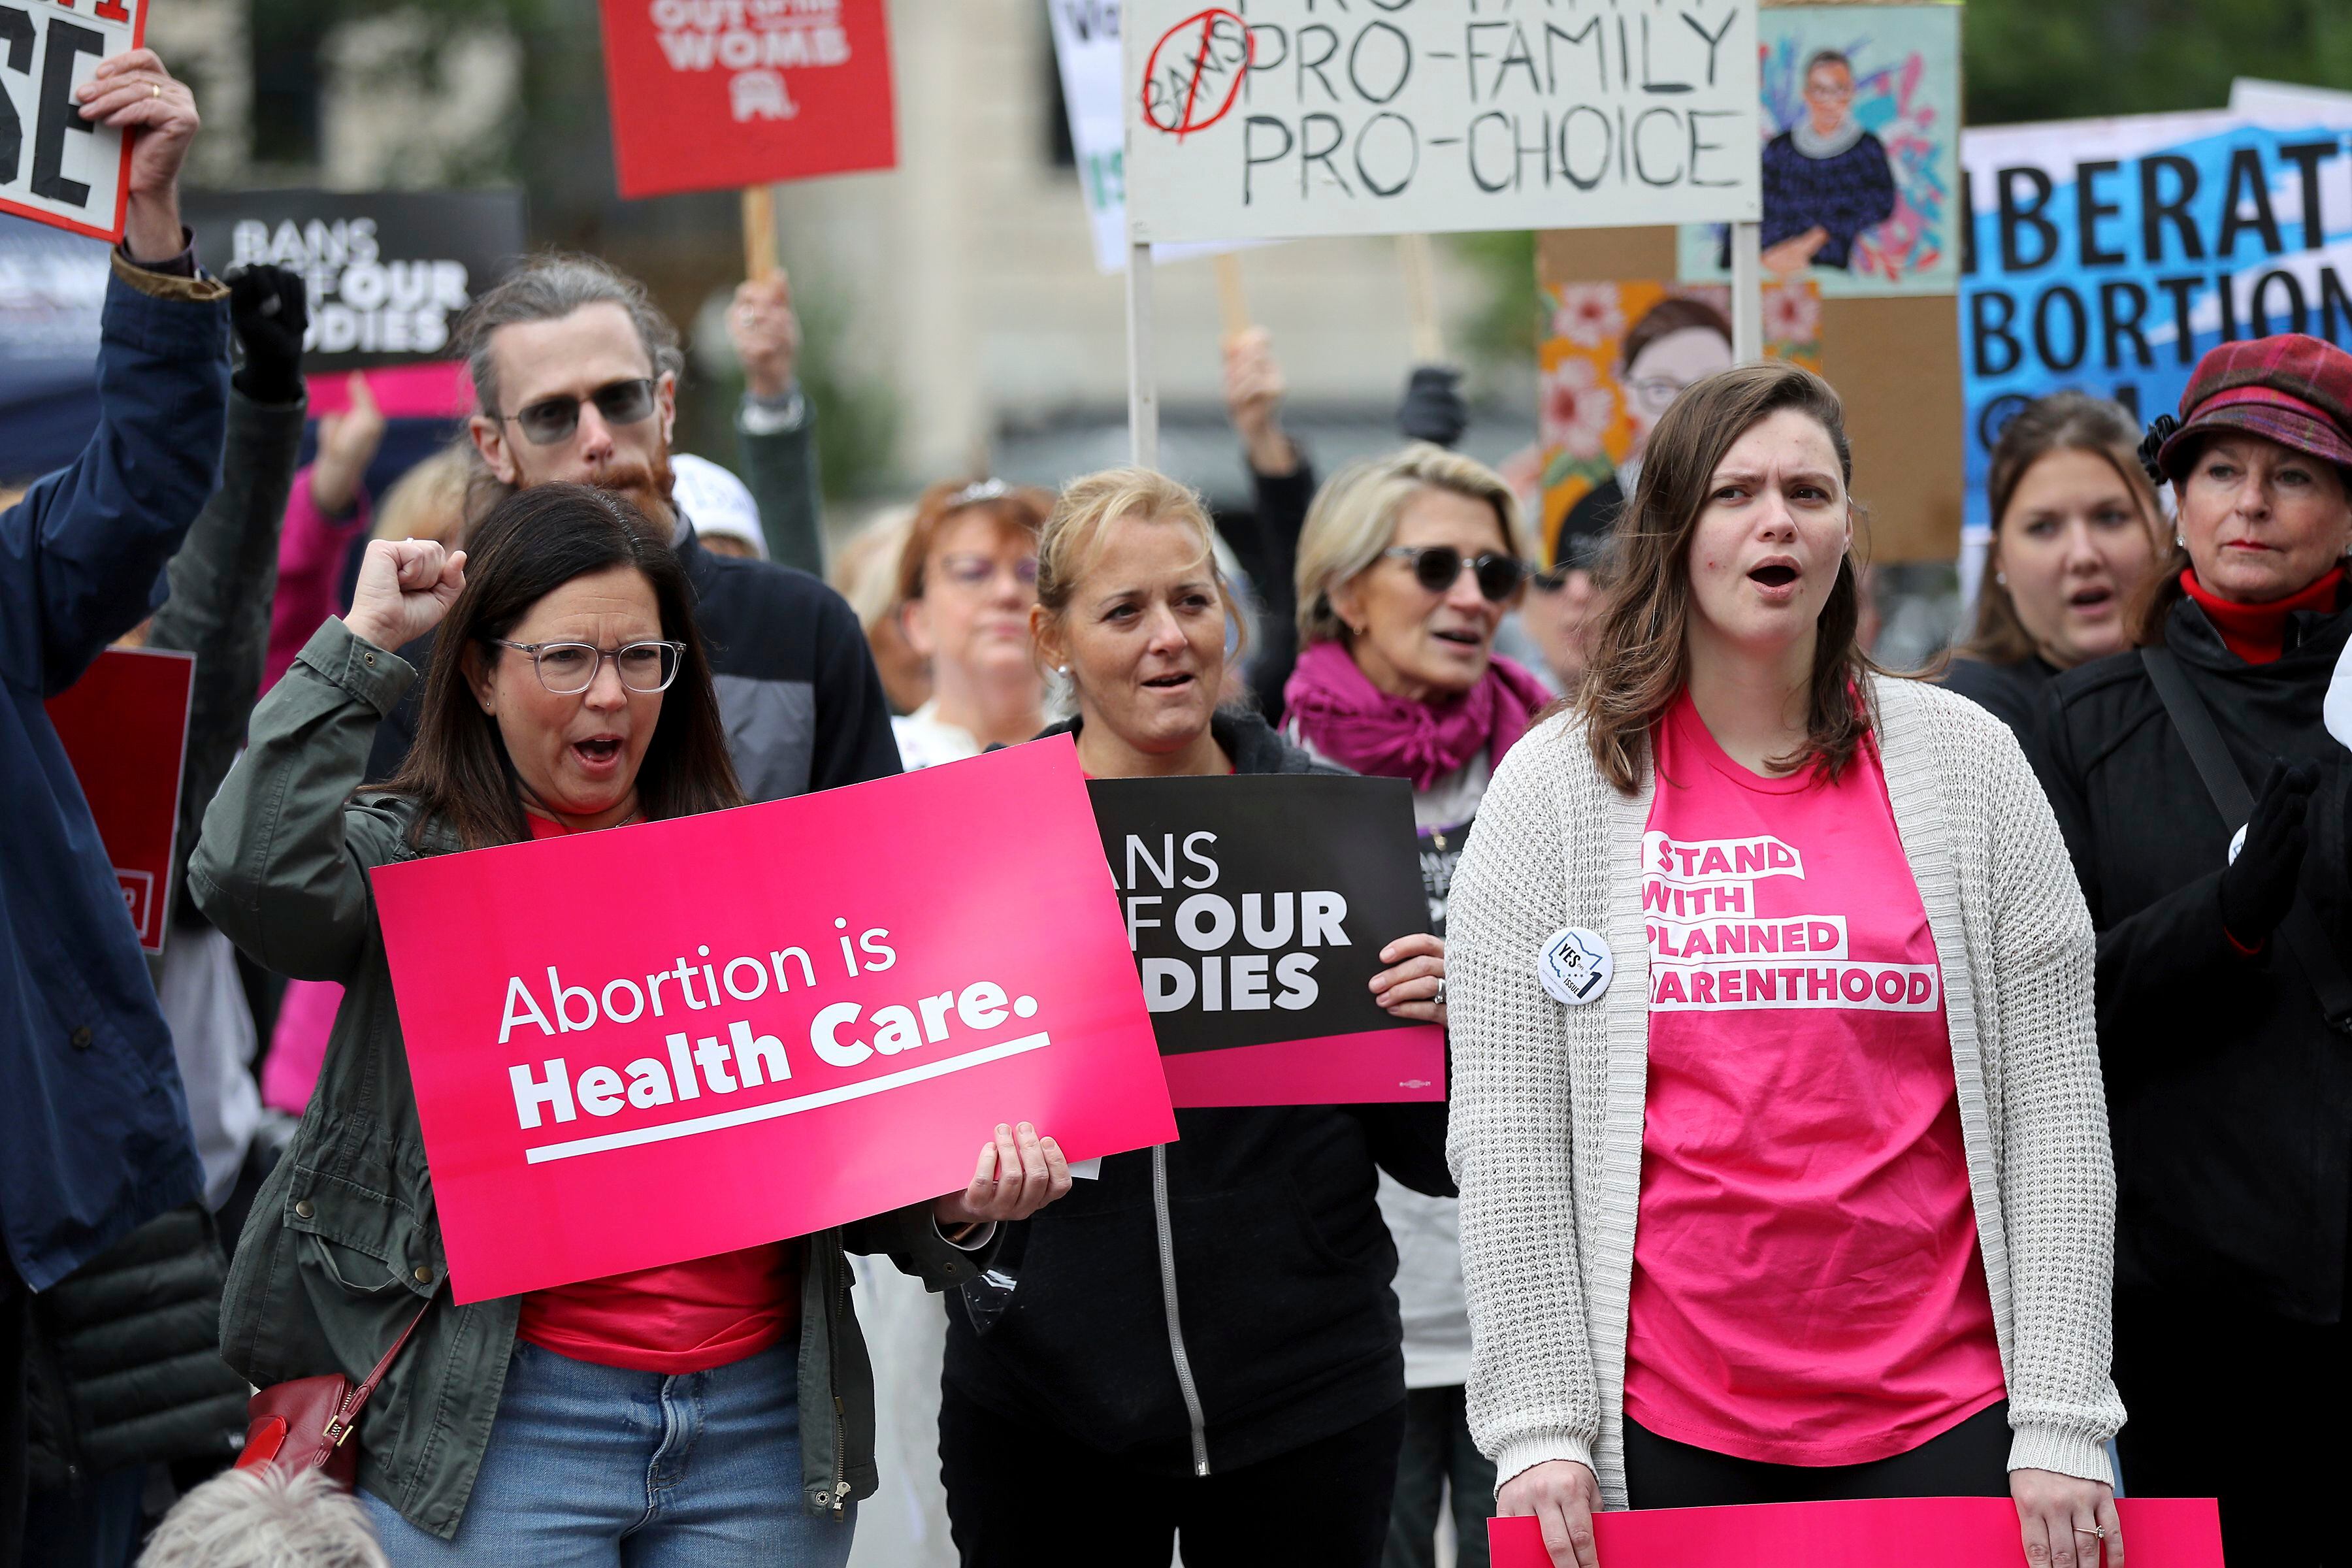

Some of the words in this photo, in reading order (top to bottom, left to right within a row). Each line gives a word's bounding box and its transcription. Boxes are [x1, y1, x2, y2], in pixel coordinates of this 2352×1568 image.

[655, 28, 852, 72] WOMB
[1139, 20, 1246, 133] BANS
[1243, 8, 1740, 105] PRO-FAMILY
[1243, 104, 1744, 206] PRO-CHOICE
[1962, 142, 2352, 274] IBERAT
[233, 217, 380, 267] BANS
[338, 259, 471, 311] OUR
[1972, 267, 2352, 377] BORTION
[1107, 830, 1220, 889] NS
[1658, 840, 1797, 877] STAND
[1116, 896, 1163, 951] F
[1174, 890, 1353, 952] OUR
[1642, 880, 1745, 917] WITH
[498, 945, 816, 1044] Abortion
[834, 917, 896, 977] is
[1141, 952, 1320, 1013] DIES
[1558, 943, 1581, 968] YES
[1563, 977, 1580, 995] ISSUE
[1650, 968, 1933, 1005] ARENTHOOD
[508, 1020, 792, 1130] Health
[810, 981, 1039, 1067] Care.
